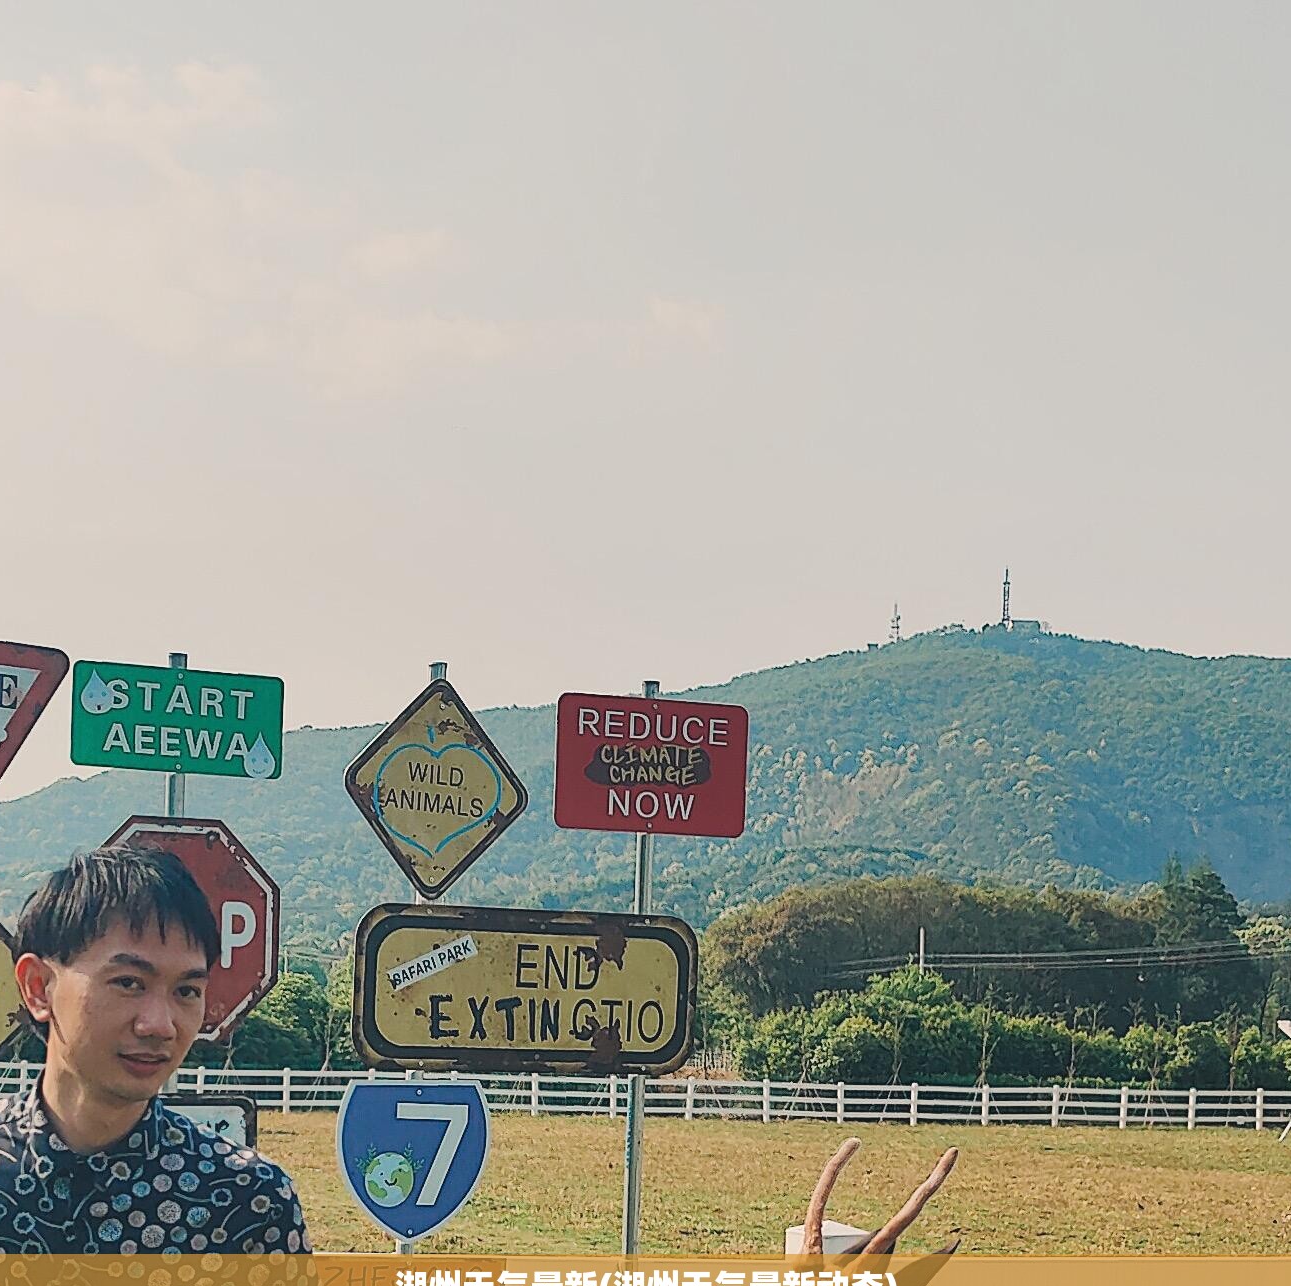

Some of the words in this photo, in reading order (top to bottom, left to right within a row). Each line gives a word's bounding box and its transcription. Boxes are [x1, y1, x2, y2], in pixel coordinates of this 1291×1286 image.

[106, 678, 254, 720] START
[102, 722, 249, 761] AEEWA
[577, 707, 729, 746] REDUCE
[408, 761, 464, 787] WILD
[600, 743, 703, 767] CLIMATE
[609, 764, 697, 786] CHANGE
[384, 788, 484, 818] ANIMALS
[607, 788, 695, 821] NOW
[392, 956, 437, 987] SAFARI
[437, 939, 472, 966] PARK
[515, 942, 602, 991] END
[395, 1102, 469, 1207] 7
